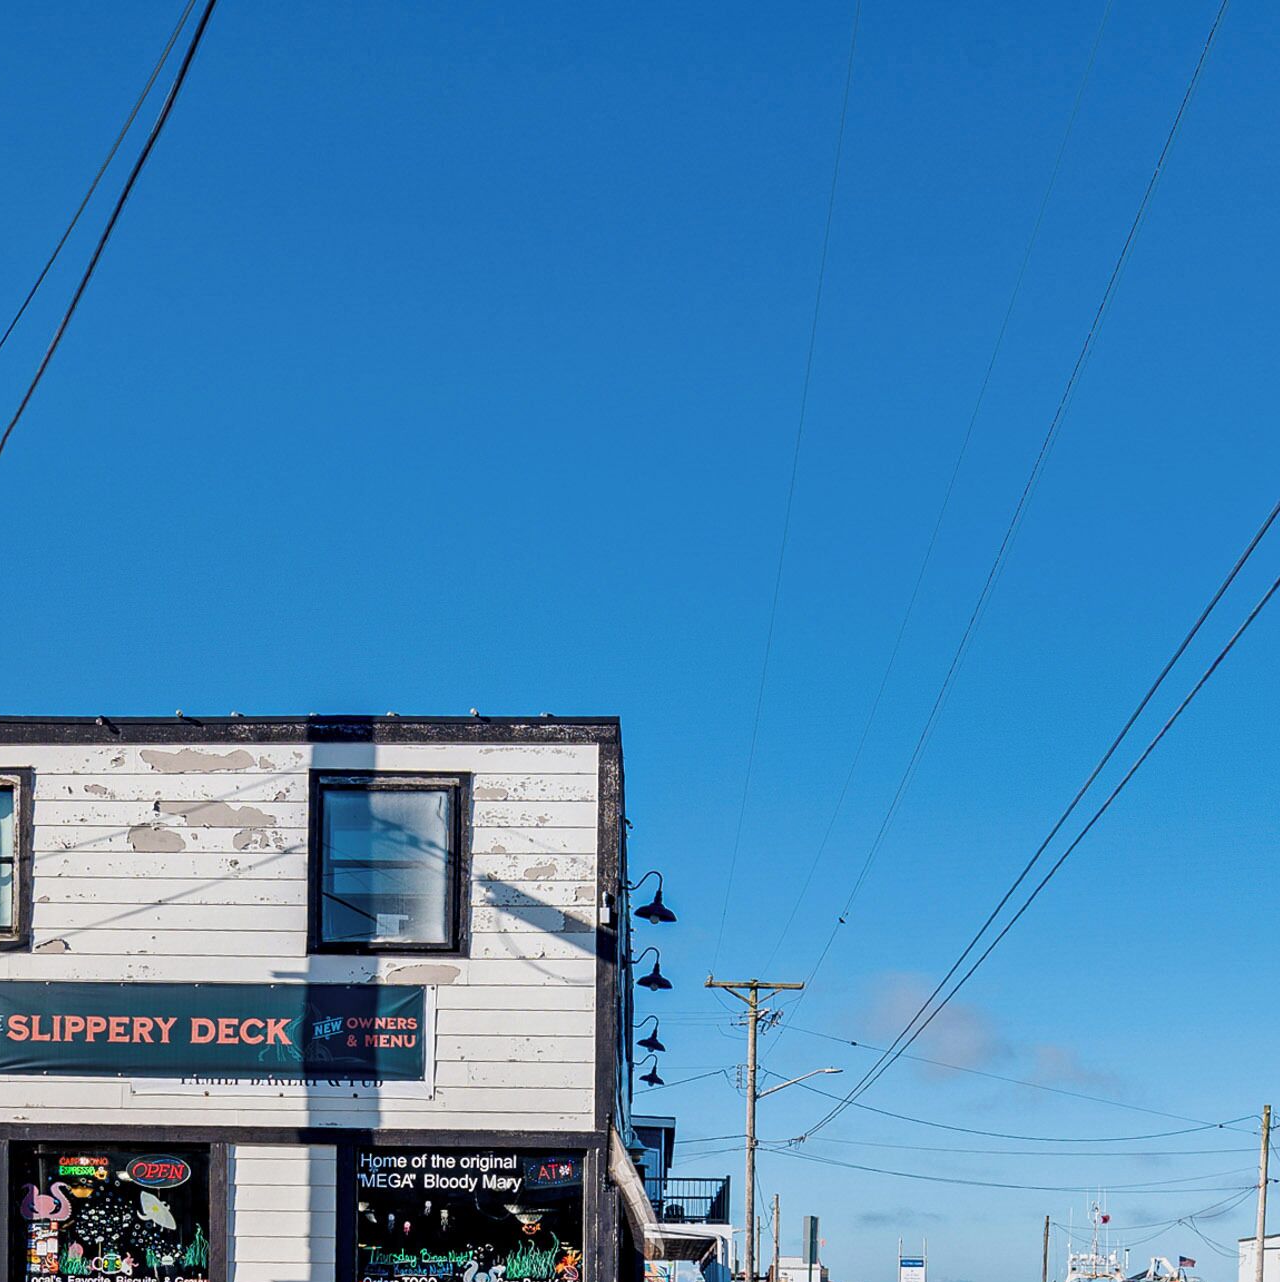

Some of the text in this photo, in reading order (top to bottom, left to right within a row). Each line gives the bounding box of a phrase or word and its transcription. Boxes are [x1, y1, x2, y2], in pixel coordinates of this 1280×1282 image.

[6, 1014, 178, 1044] SLIPPERY
[190, 1017, 293, 1045] DECK
[313, 1017, 418, 1036] NEW OWNERS
[346, 1034, 417, 1048] & MENU
[132, 1162, 185, 1180] OPEN
[360, 1153, 517, 1172] Home of the original
[357, 1173, 522, 1192] "MEGA" Bloody Mary
